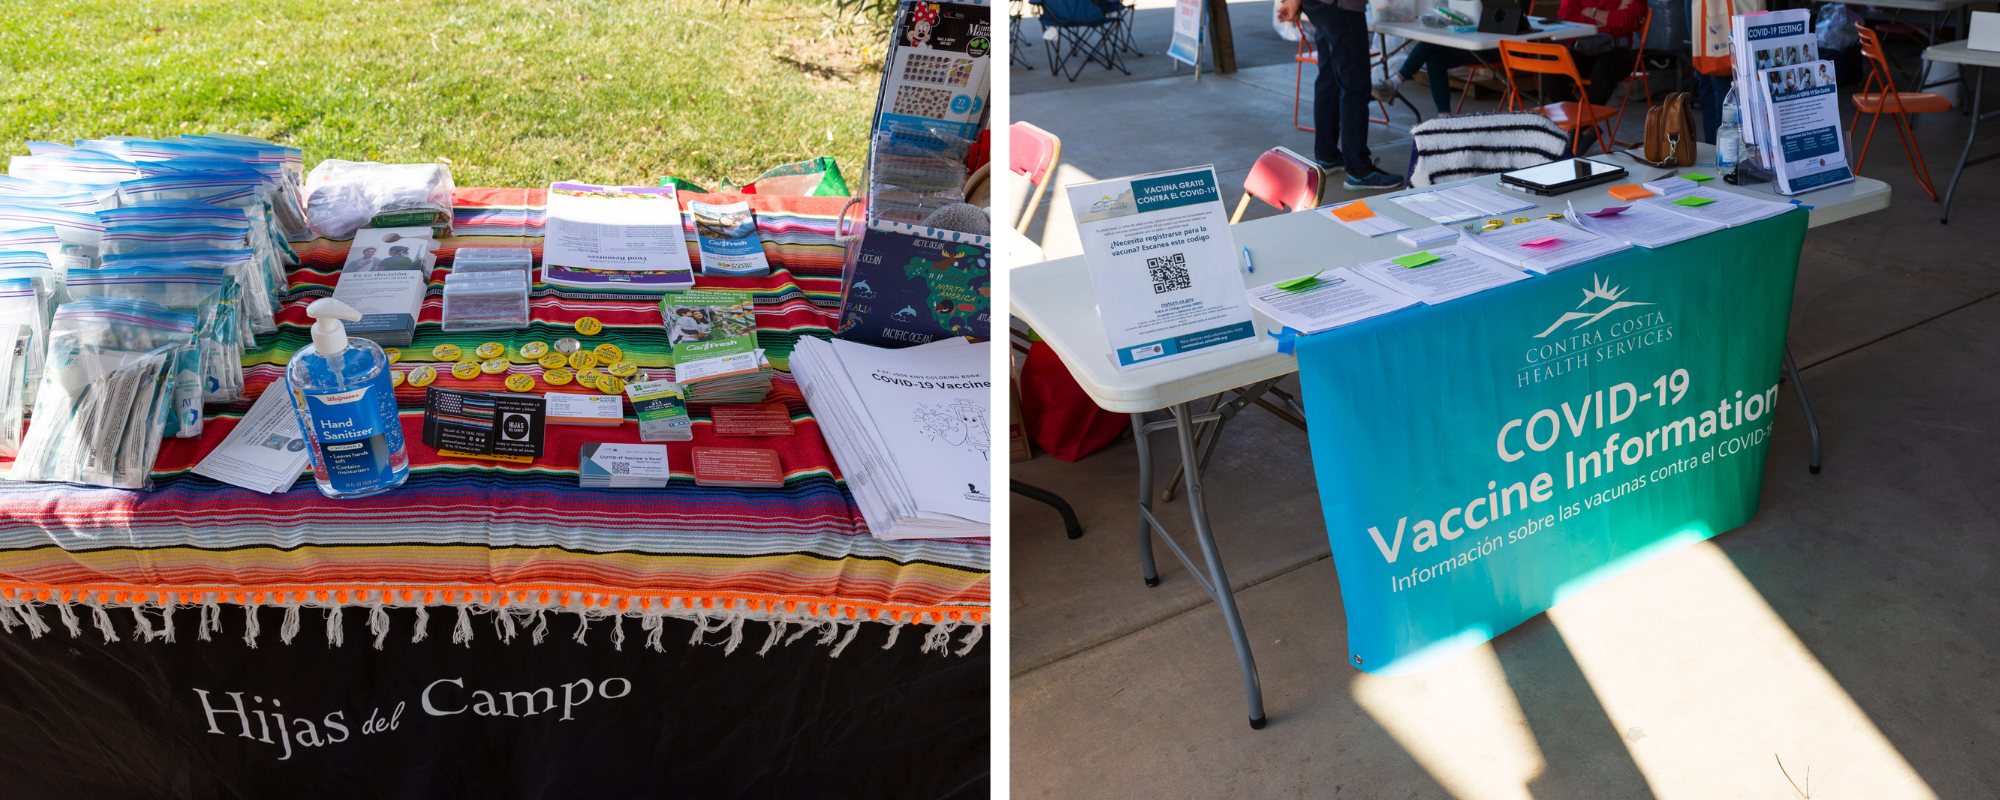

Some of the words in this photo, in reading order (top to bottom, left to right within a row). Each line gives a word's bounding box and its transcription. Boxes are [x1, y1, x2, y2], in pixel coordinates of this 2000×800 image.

[1748, 26, 1777, 38] COVID-19
[1778, 24, 1802, 34] TESTING
[1144, 183, 1178, 194] VACUNA
[1179, 180, 1204, 189] GRATIS
[1137, 194, 1169, 204] CONTRA
[1180, 187, 1215, 198] COVID-19
[929, 241, 944, 250] OCEAN
[1110, 238, 1143, 249] ¿Necesita
[1146, 230, 1182, 242] registrarse
[1184, 228, 1198, 236] para
[1112, 246, 1140, 256] vacuna?
[1142, 242, 1170, 252] Escanea
[1187, 234, 1210, 244] codigo
[862, 253, 882, 265] OCEAN
[935, 284, 964, 293] NORTH
[938, 292, 976, 302] AMERICA
[882, 328, 907, 341] PACIFIC
[909, 333, 933, 343] OCEAN
[1526, 330, 1602, 363] CONTRA
[1610, 311, 1664, 338] COSTA
[686, 340, 737, 351] CalFresh
[1518, 353, 1588, 388] HEALTH
[1597, 327, 1673, 362] SERVICES
[453, 363, 477, 371] COVID-19
[872, 373, 933, 389] COVID-19
[936, 381, 991, 389] Vaccine
[326, 393, 359, 402] Walgreens
[1496, 368, 1690, 462] COVID-19
[321, 418, 353, 429] Hand
[323, 427, 373, 440] Sanitizer
[1367, 480, 1555, 564] Vaccine
[1565, 383, 1779, 490] Information
[1391, 533, 1504, 594] Información
[1508, 513, 1555, 545] sobre
[1559, 498, 1581, 522] las
[1584, 474, 1647, 509] vacunas
[1650, 456, 1697, 485] contra
[1702, 446, 1714, 464] el
[192, 688, 349, 760] Hijas
[362, 700, 406, 735] del
[421, 677, 632, 722] Campo
